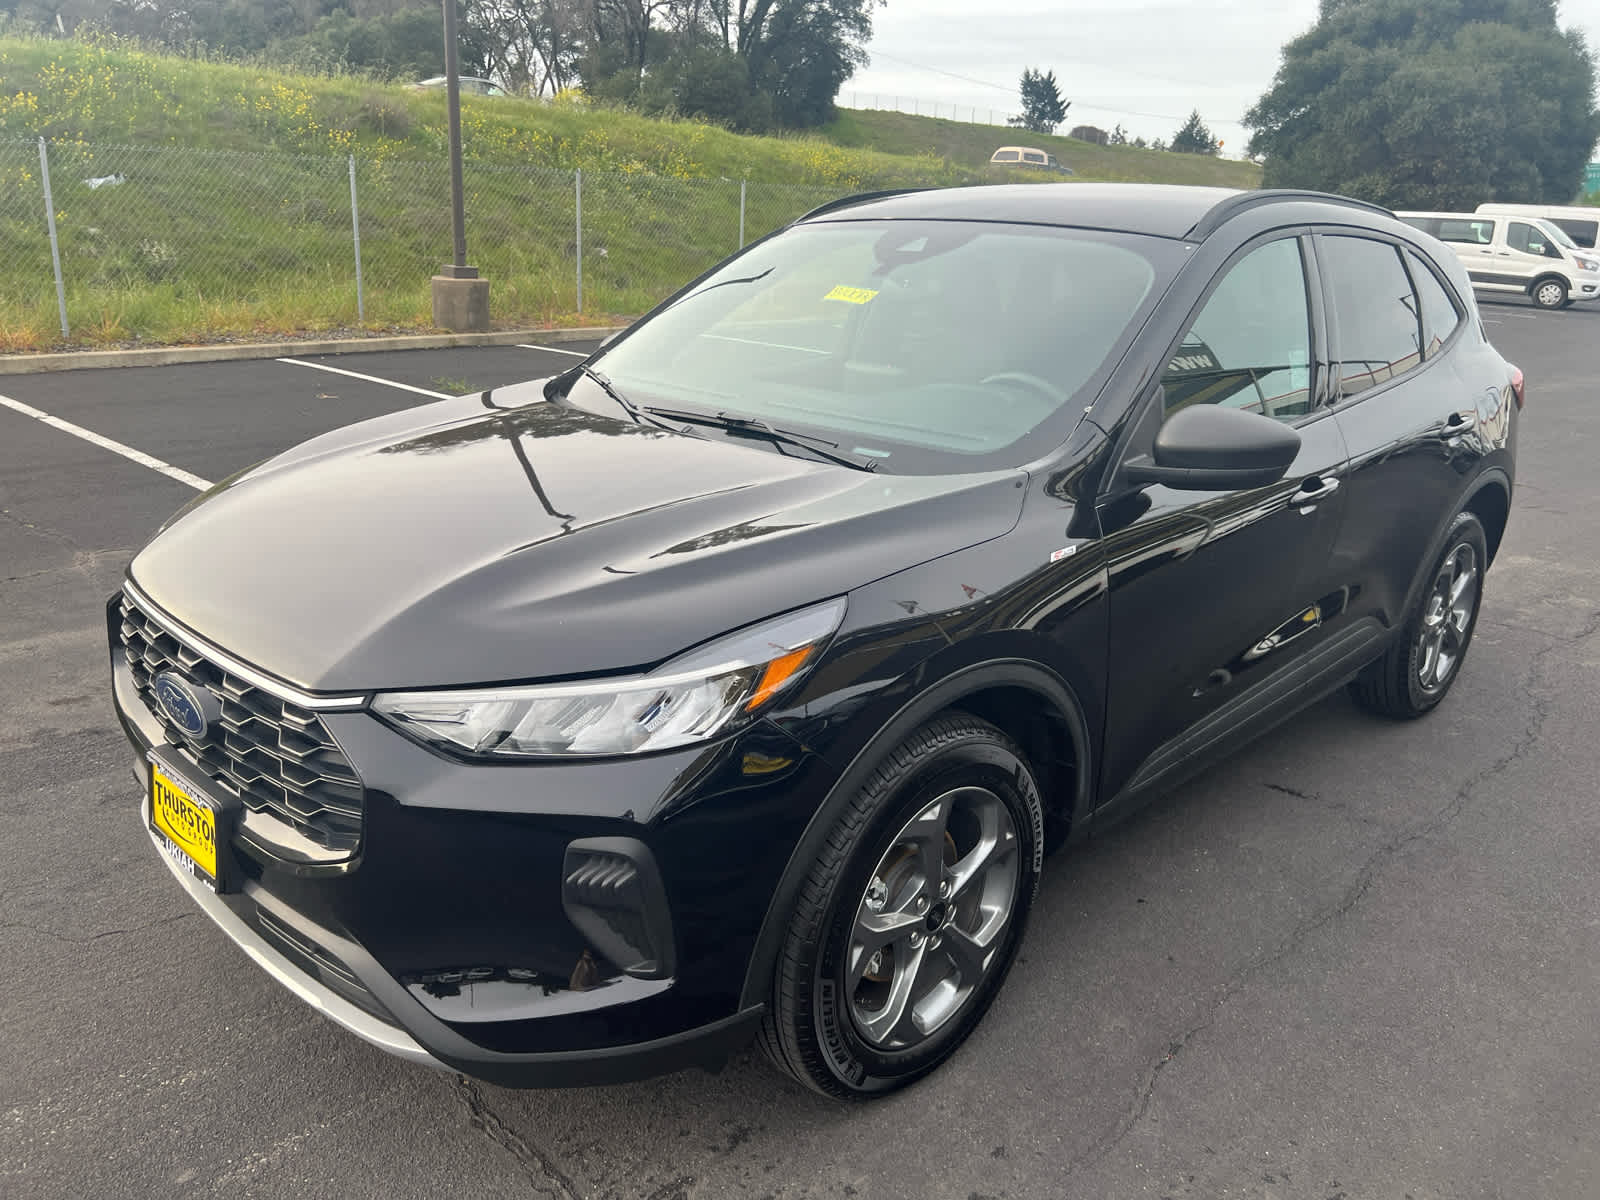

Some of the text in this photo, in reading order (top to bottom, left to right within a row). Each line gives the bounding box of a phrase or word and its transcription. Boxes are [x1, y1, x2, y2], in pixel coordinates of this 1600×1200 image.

[162, 686, 191, 727] Ford
[165, 838, 195, 876] UKIAH
[1027, 792, 1042, 870] MICHELIN
[823, 984, 848, 1064] MICHELIN
